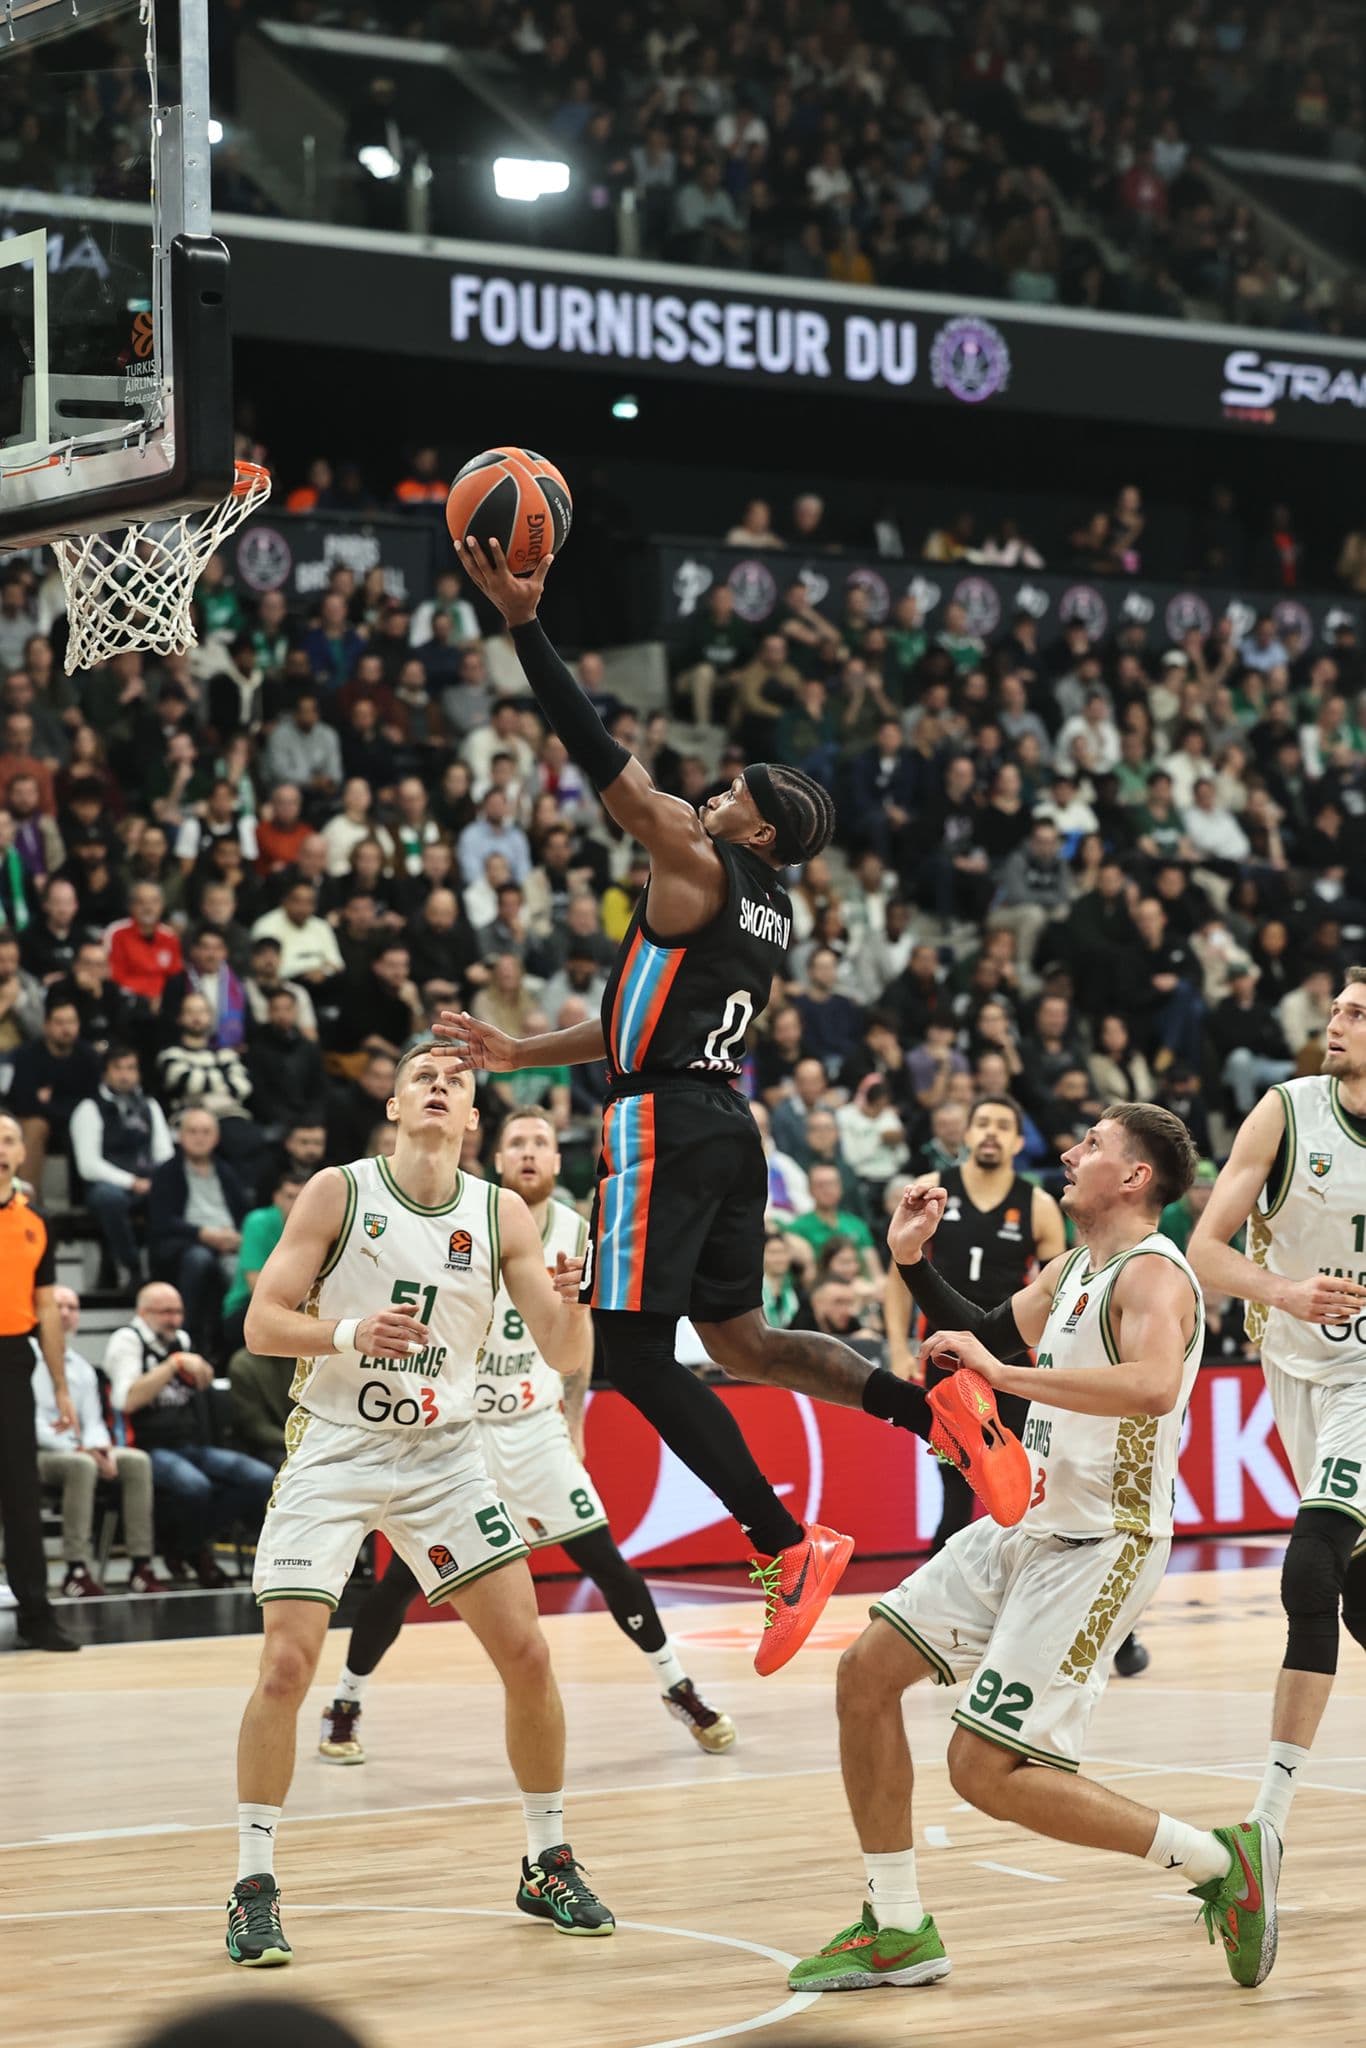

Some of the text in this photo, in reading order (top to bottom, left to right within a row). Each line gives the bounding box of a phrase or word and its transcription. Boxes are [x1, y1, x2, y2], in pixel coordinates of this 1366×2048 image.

[450, 273, 831, 378] FOURNISSEUR
[843, 315, 917, 386] DU
[125, 360, 157, 379] TURKIS
[125, 375, 156, 393] AIRLIN
[1220, 350, 1366, 409] STRA
[739, 896, 783, 946] SHORTS
[704, 989, 754, 1061] 0
[968, 1246, 984, 1282] 1
[391, 1279, 439, 1327] 51
[503, 1308, 525, 1341] 8
[358, 1380, 440, 1428] Go3
[474, 1382, 536, 1414] Go3
[1319, 1456, 1362, 1499] 15
[569, 1489, 595, 1520] 8
[969, 1668, 1034, 1732] 92
